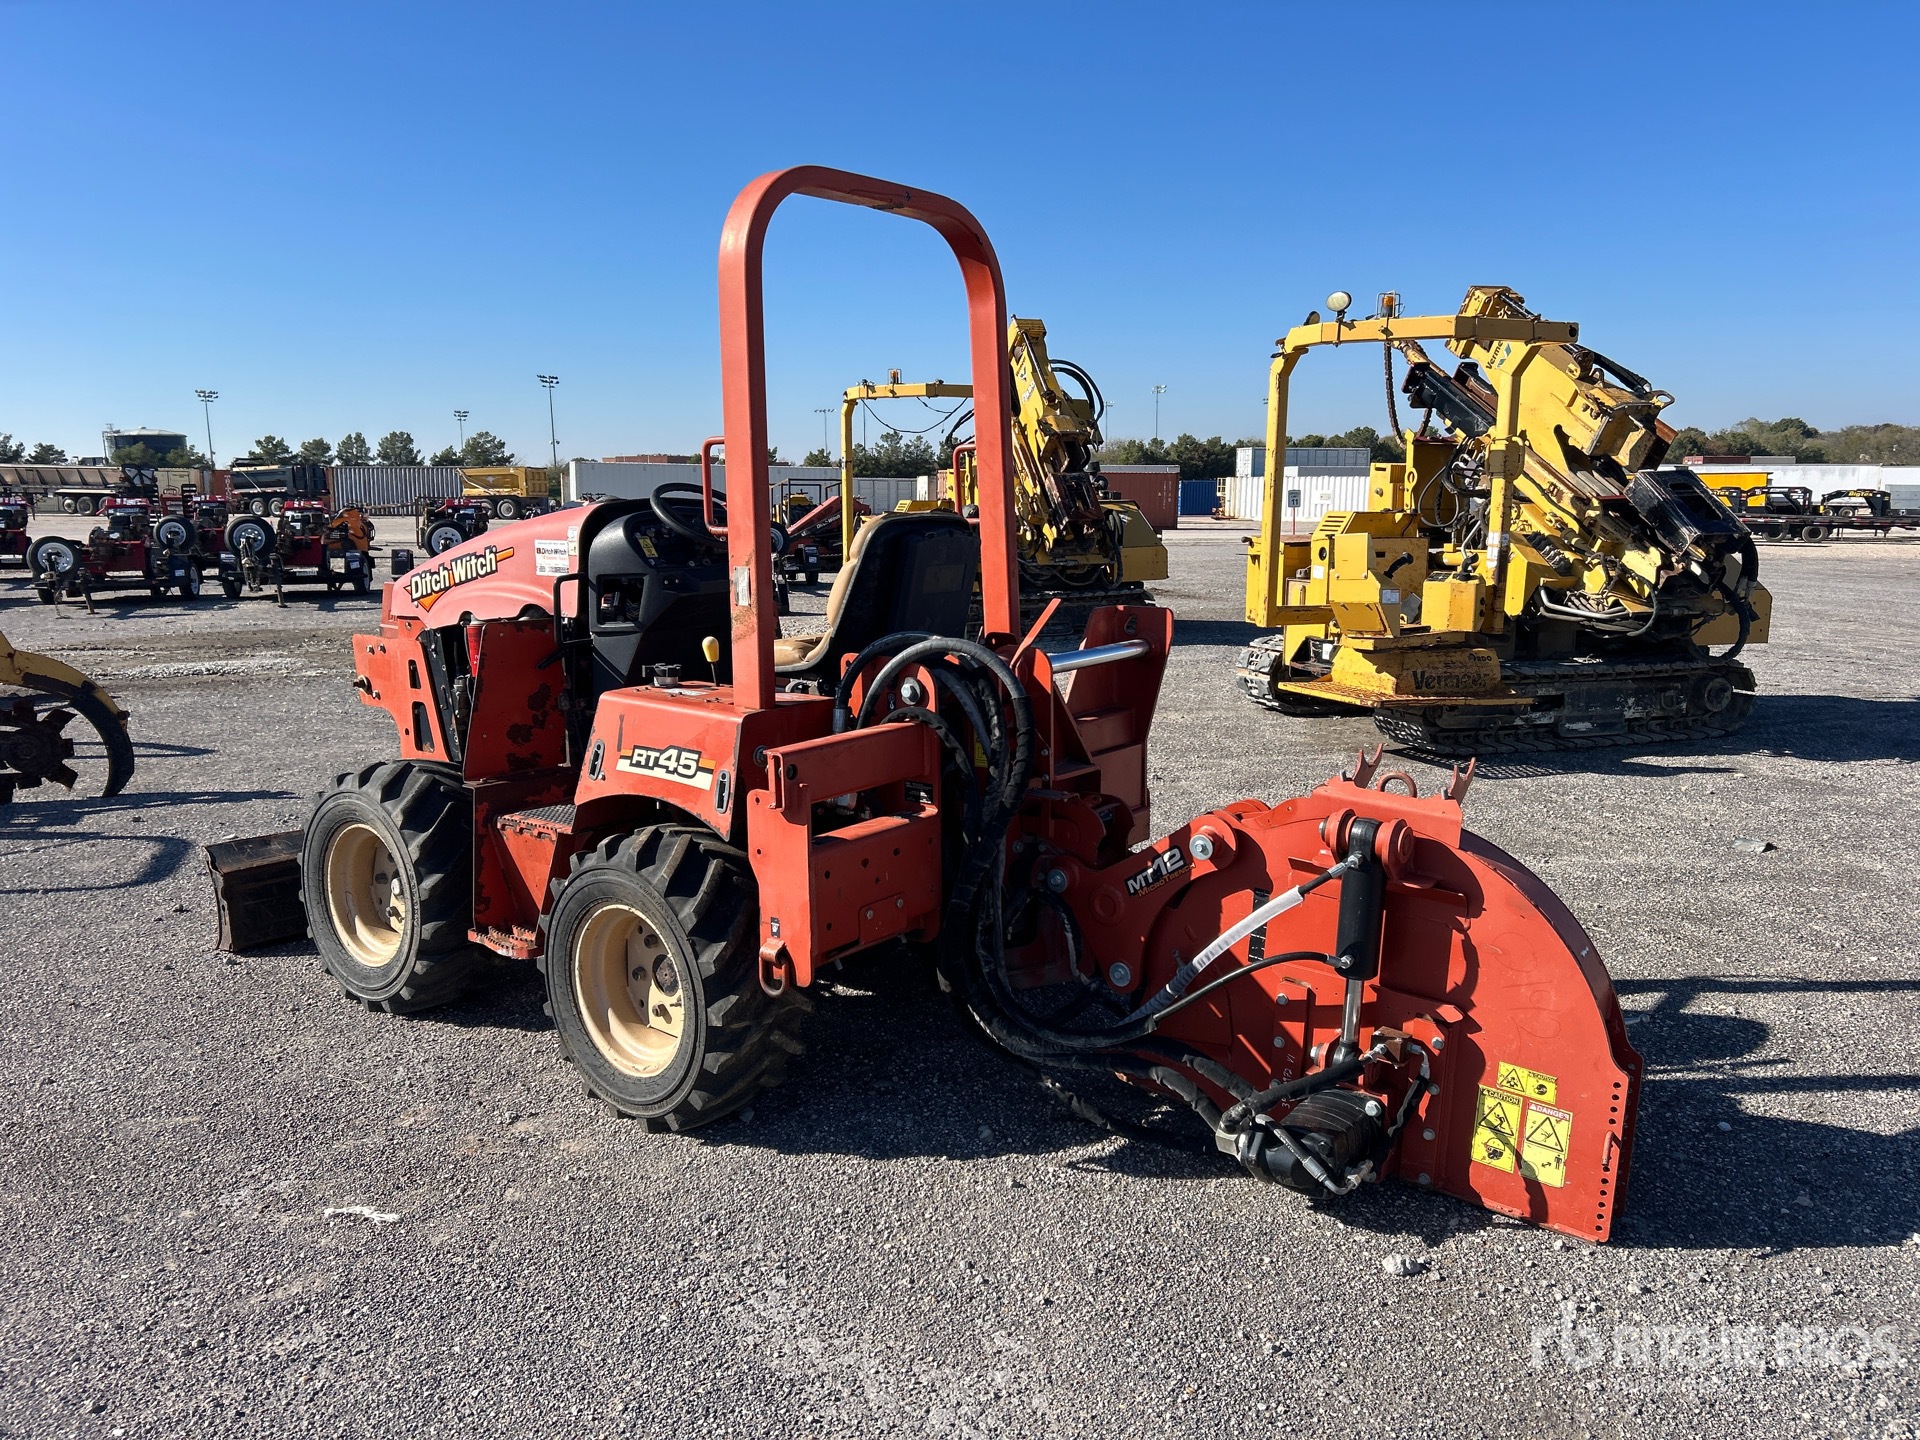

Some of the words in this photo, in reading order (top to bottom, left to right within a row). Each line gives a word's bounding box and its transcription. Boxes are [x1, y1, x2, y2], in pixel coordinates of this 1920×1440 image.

[1486, 341, 1504, 369] Verme
[411, 565, 450, 600] Ditch
[451, 546, 498, 584] Witch
[631, 747, 700, 776] RT45
[1126, 847, 1184, 894] MT12
[1489, 1090, 1519, 1105] CAUTION
[1537, 1104, 1570, 1120] DANGER
